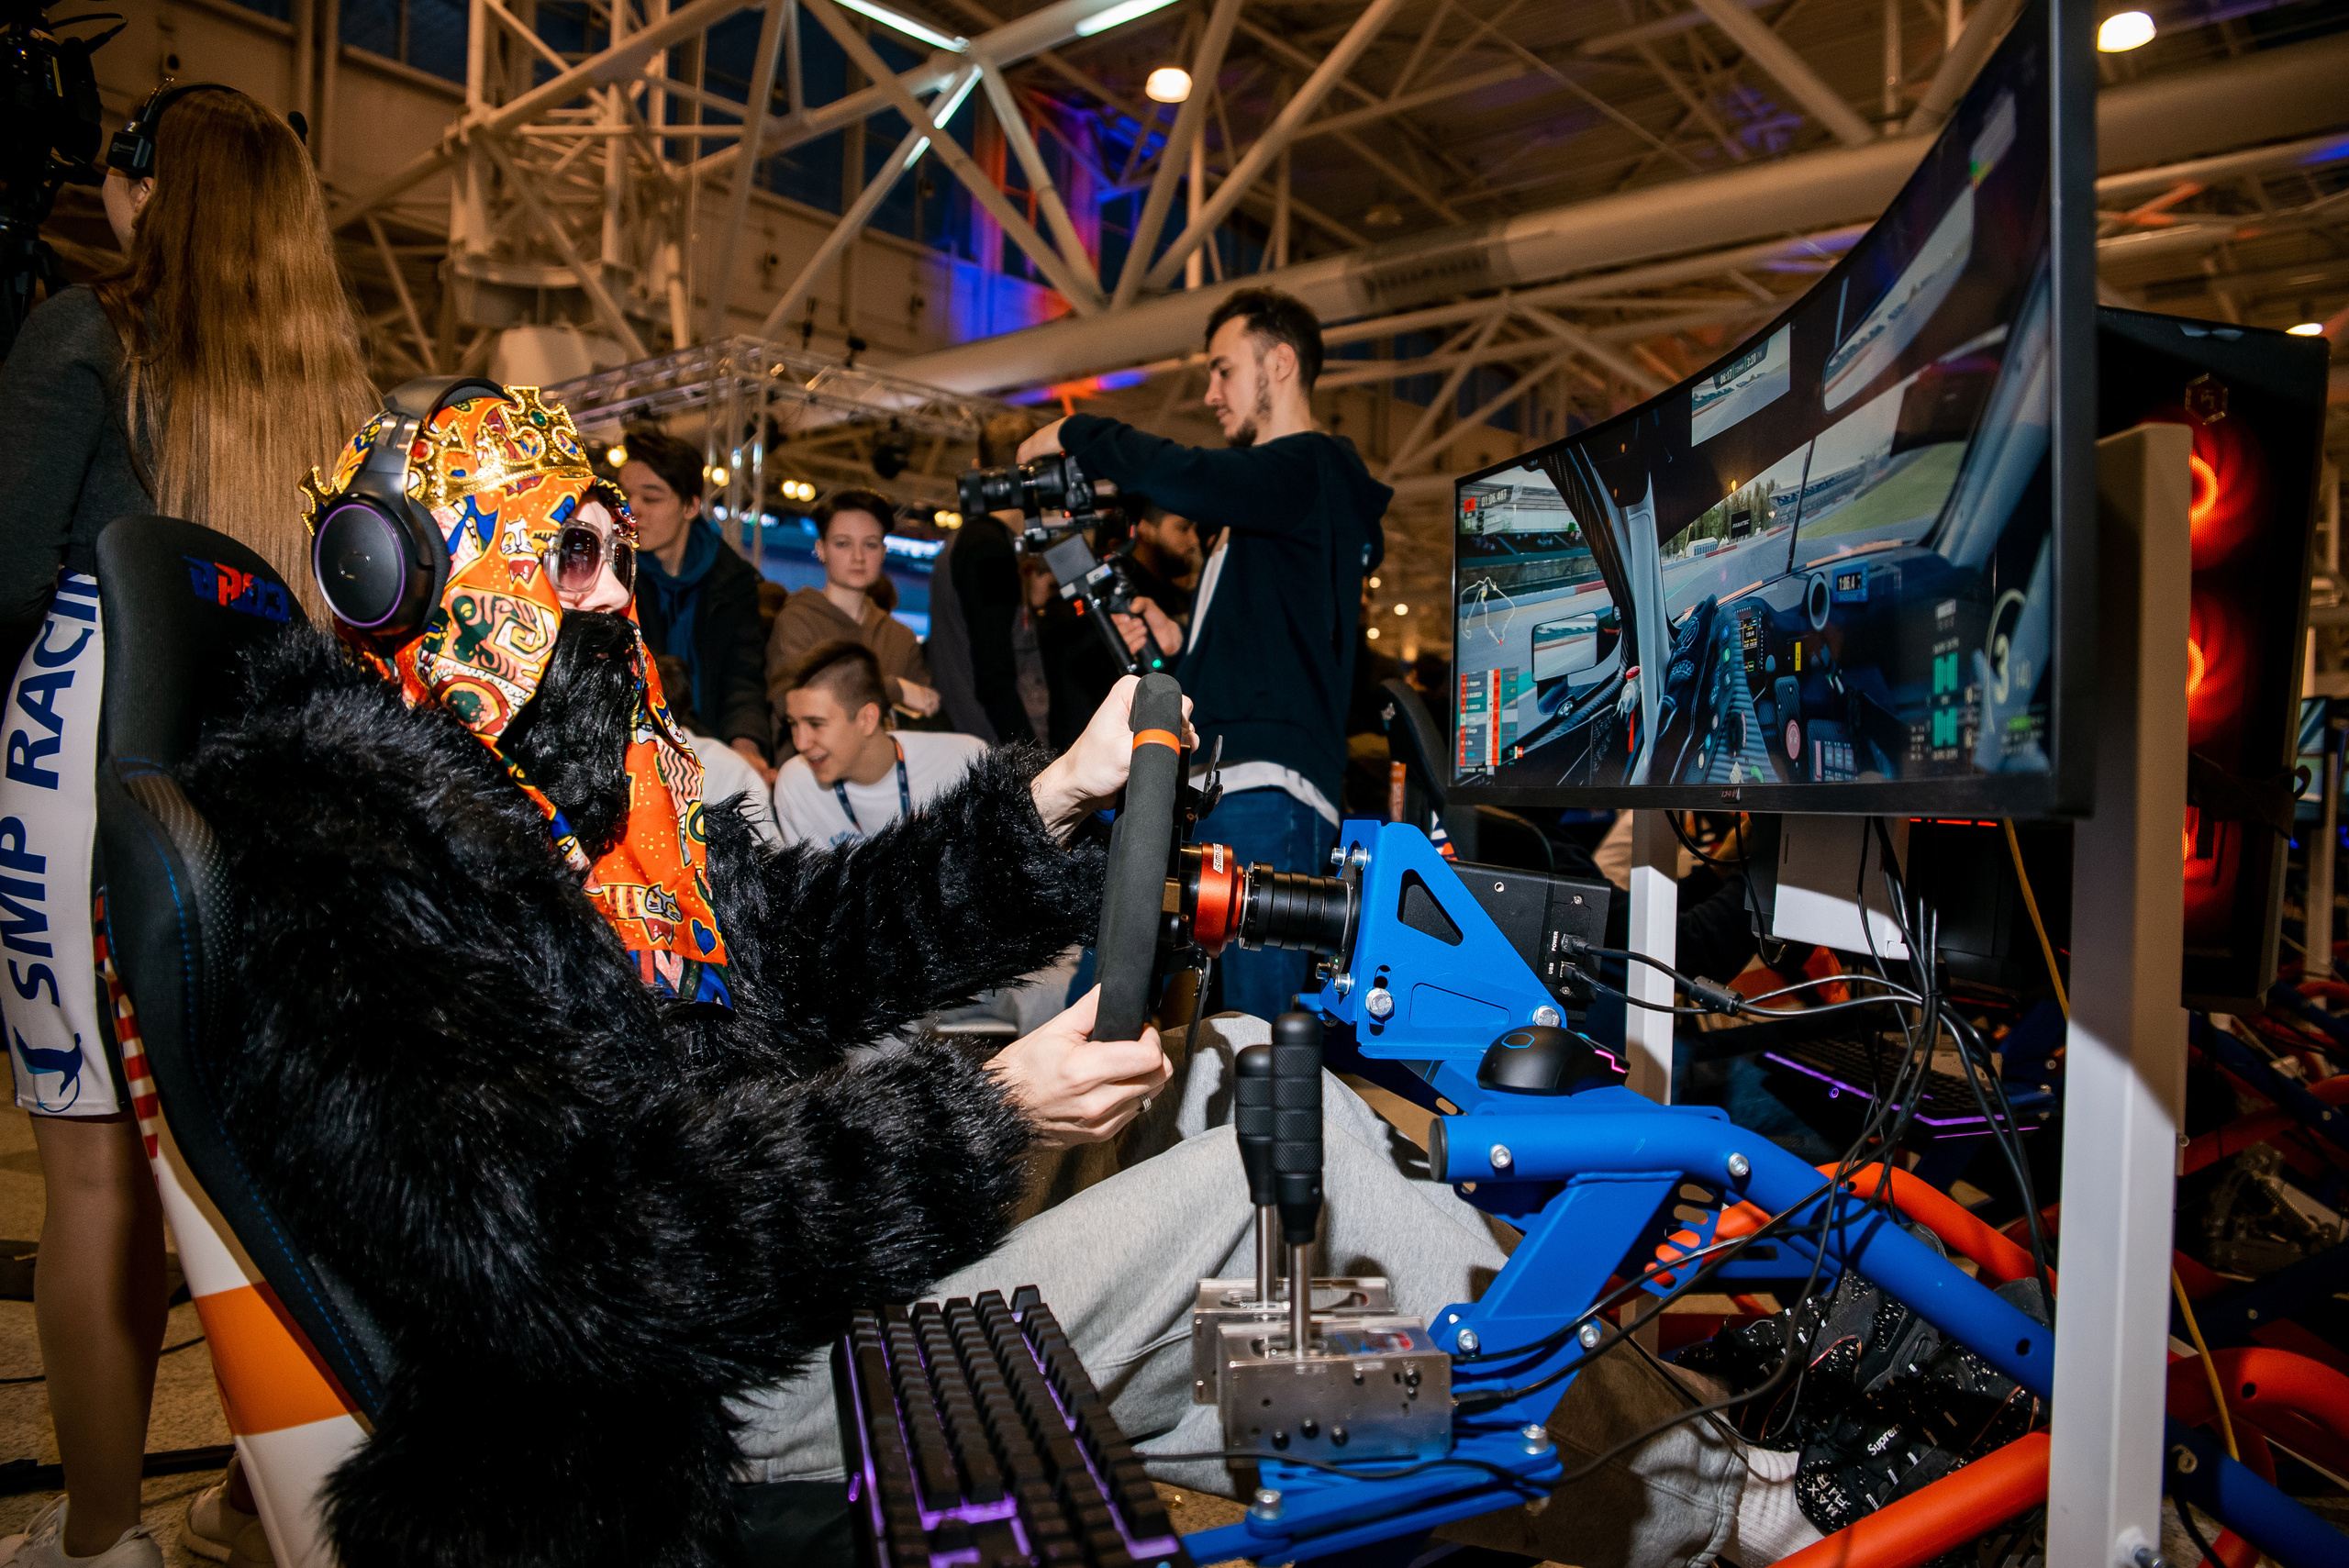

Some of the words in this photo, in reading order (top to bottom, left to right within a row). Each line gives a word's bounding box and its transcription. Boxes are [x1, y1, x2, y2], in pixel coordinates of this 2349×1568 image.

[1994, 633, 2009, 705] 3
[0, 816, 61, 1008] SMP
[1551, 930, 1559, 951] POWER
[1807, 1483, 1840, 1518] MAX
